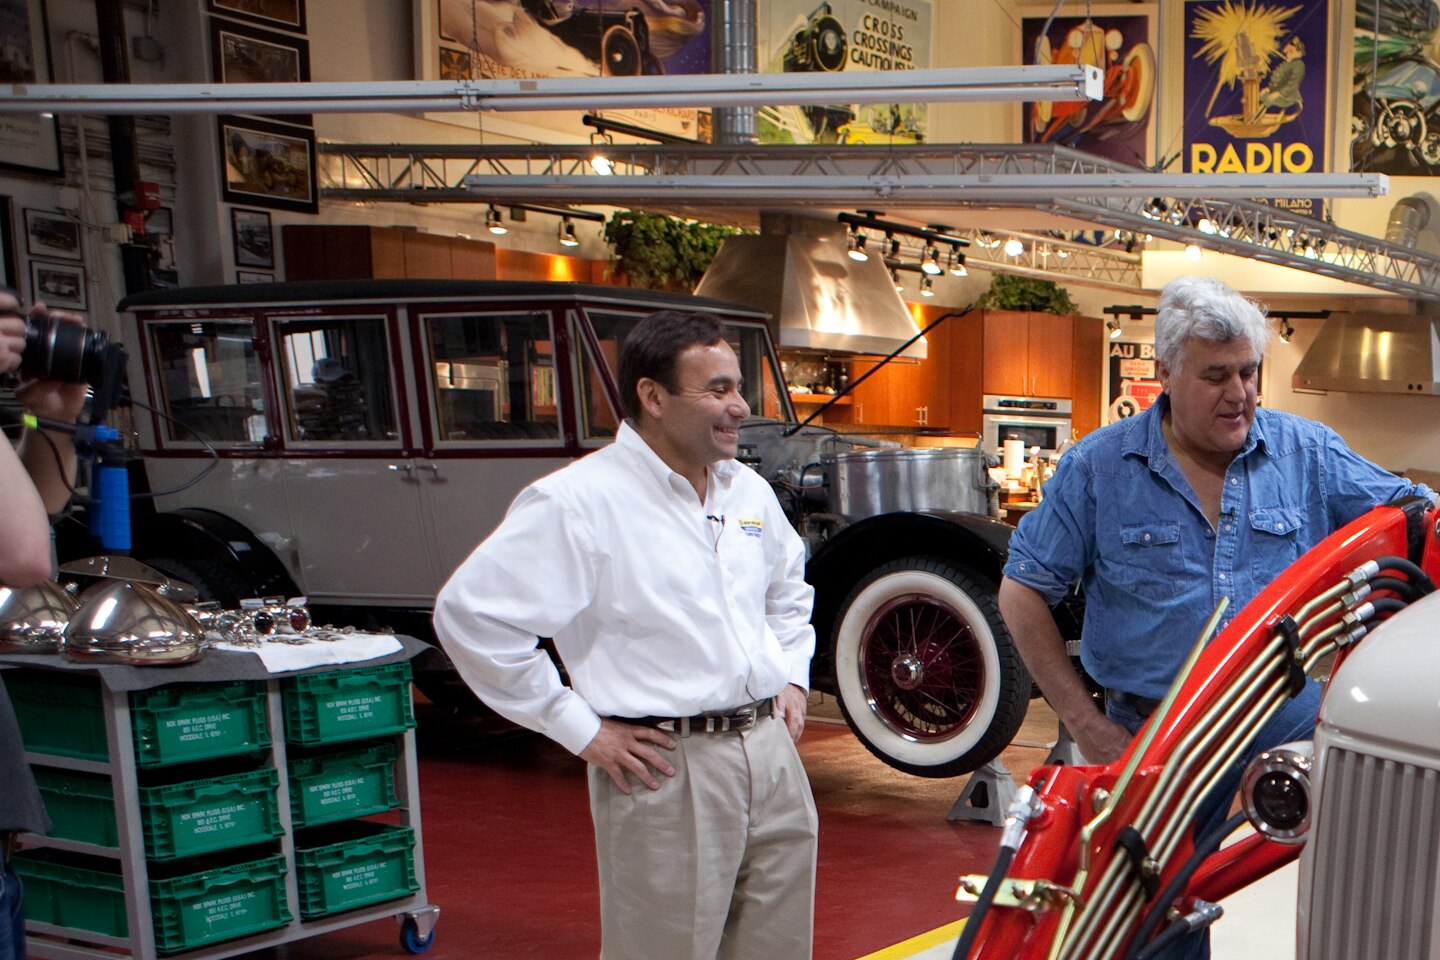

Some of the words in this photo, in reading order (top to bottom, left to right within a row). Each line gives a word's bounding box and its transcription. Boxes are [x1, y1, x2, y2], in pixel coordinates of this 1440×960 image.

[863, 14, 904, 41] CROSS
[853, 30, 913, 62] CROSSINGS
[1191, 142, 1314, 174] RADIO
[1275, 198, 1313, 209] MILANO
[1110, 343, 1135, 358] AU
